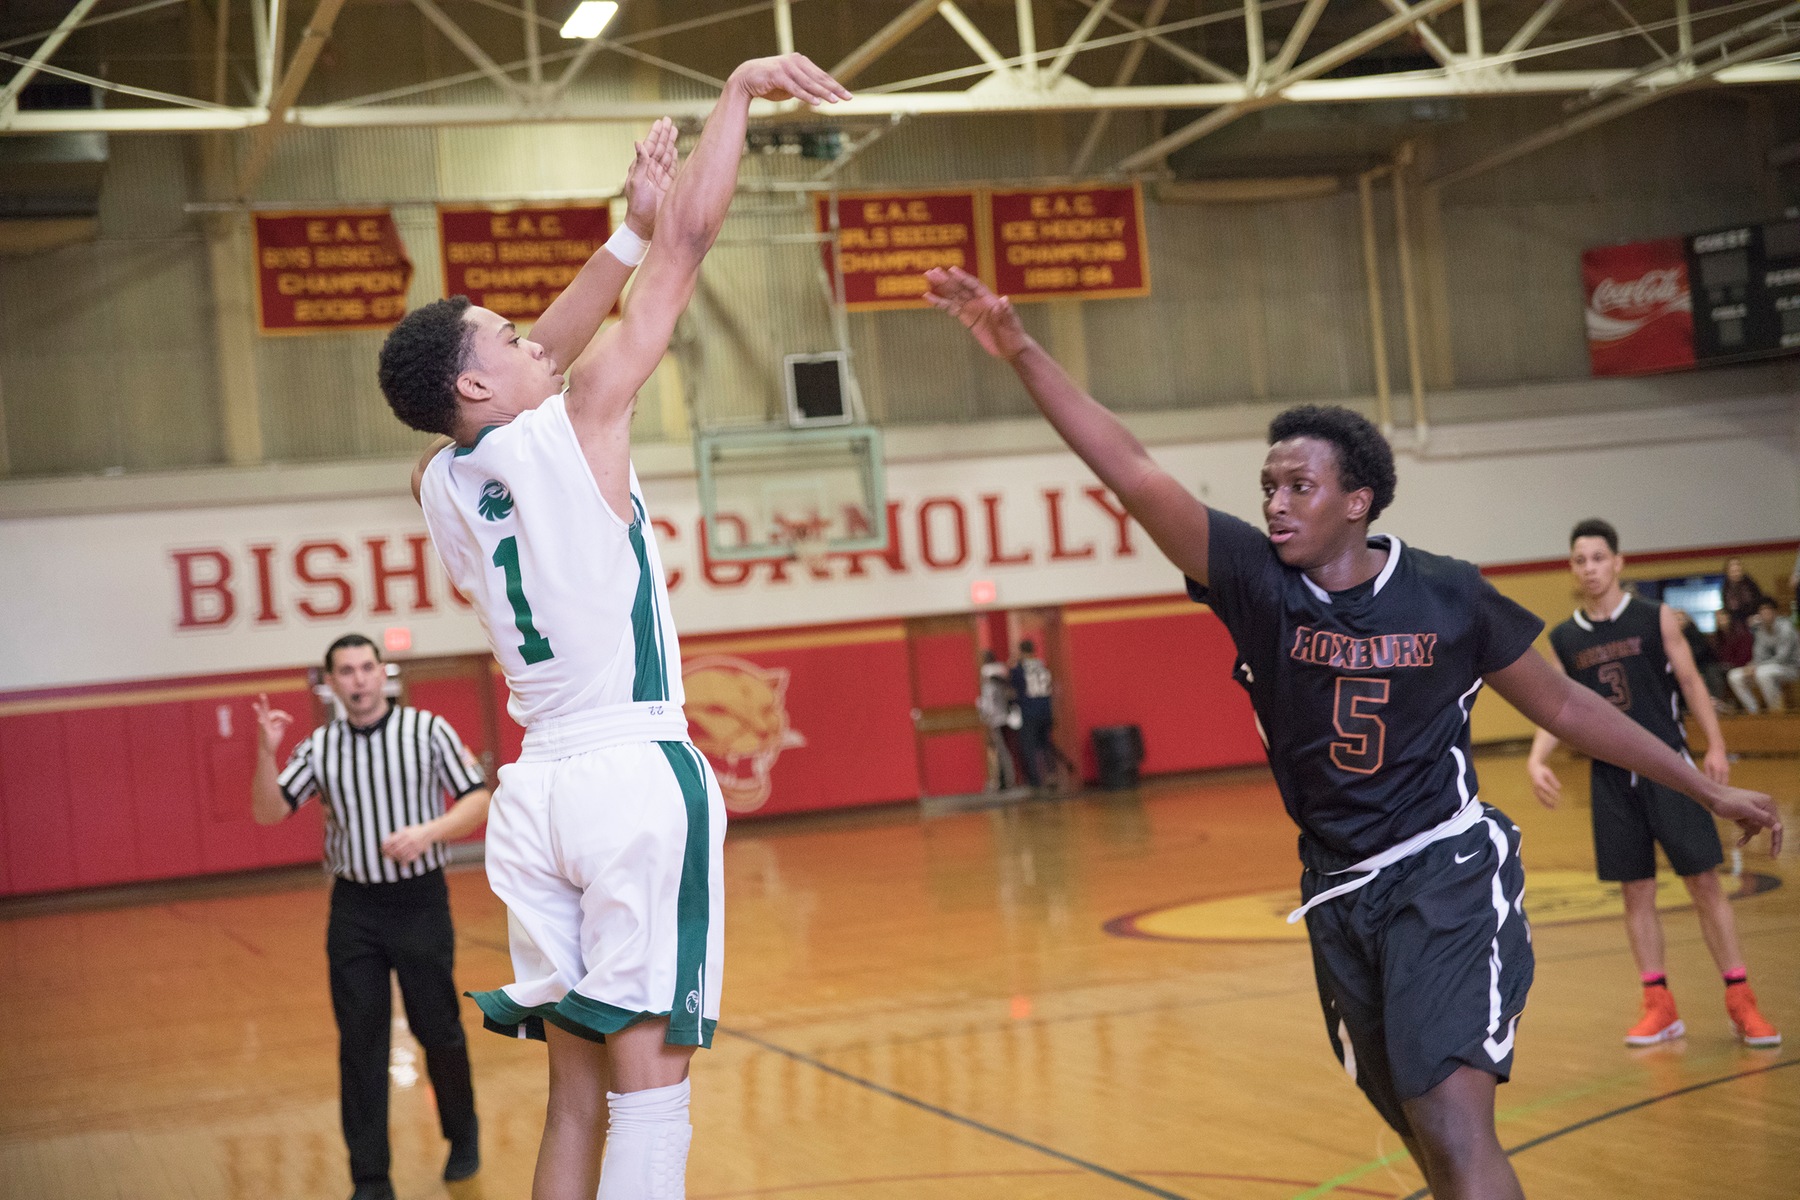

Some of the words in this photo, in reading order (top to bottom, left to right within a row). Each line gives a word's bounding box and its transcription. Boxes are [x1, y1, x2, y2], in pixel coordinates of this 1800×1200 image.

[170, 530, 473, 630] BISH
[492, 535, 555, 666] 1
[1290, 626, 1438, 670] ROXBURY
[1329, 676, 1391, 775] 5
